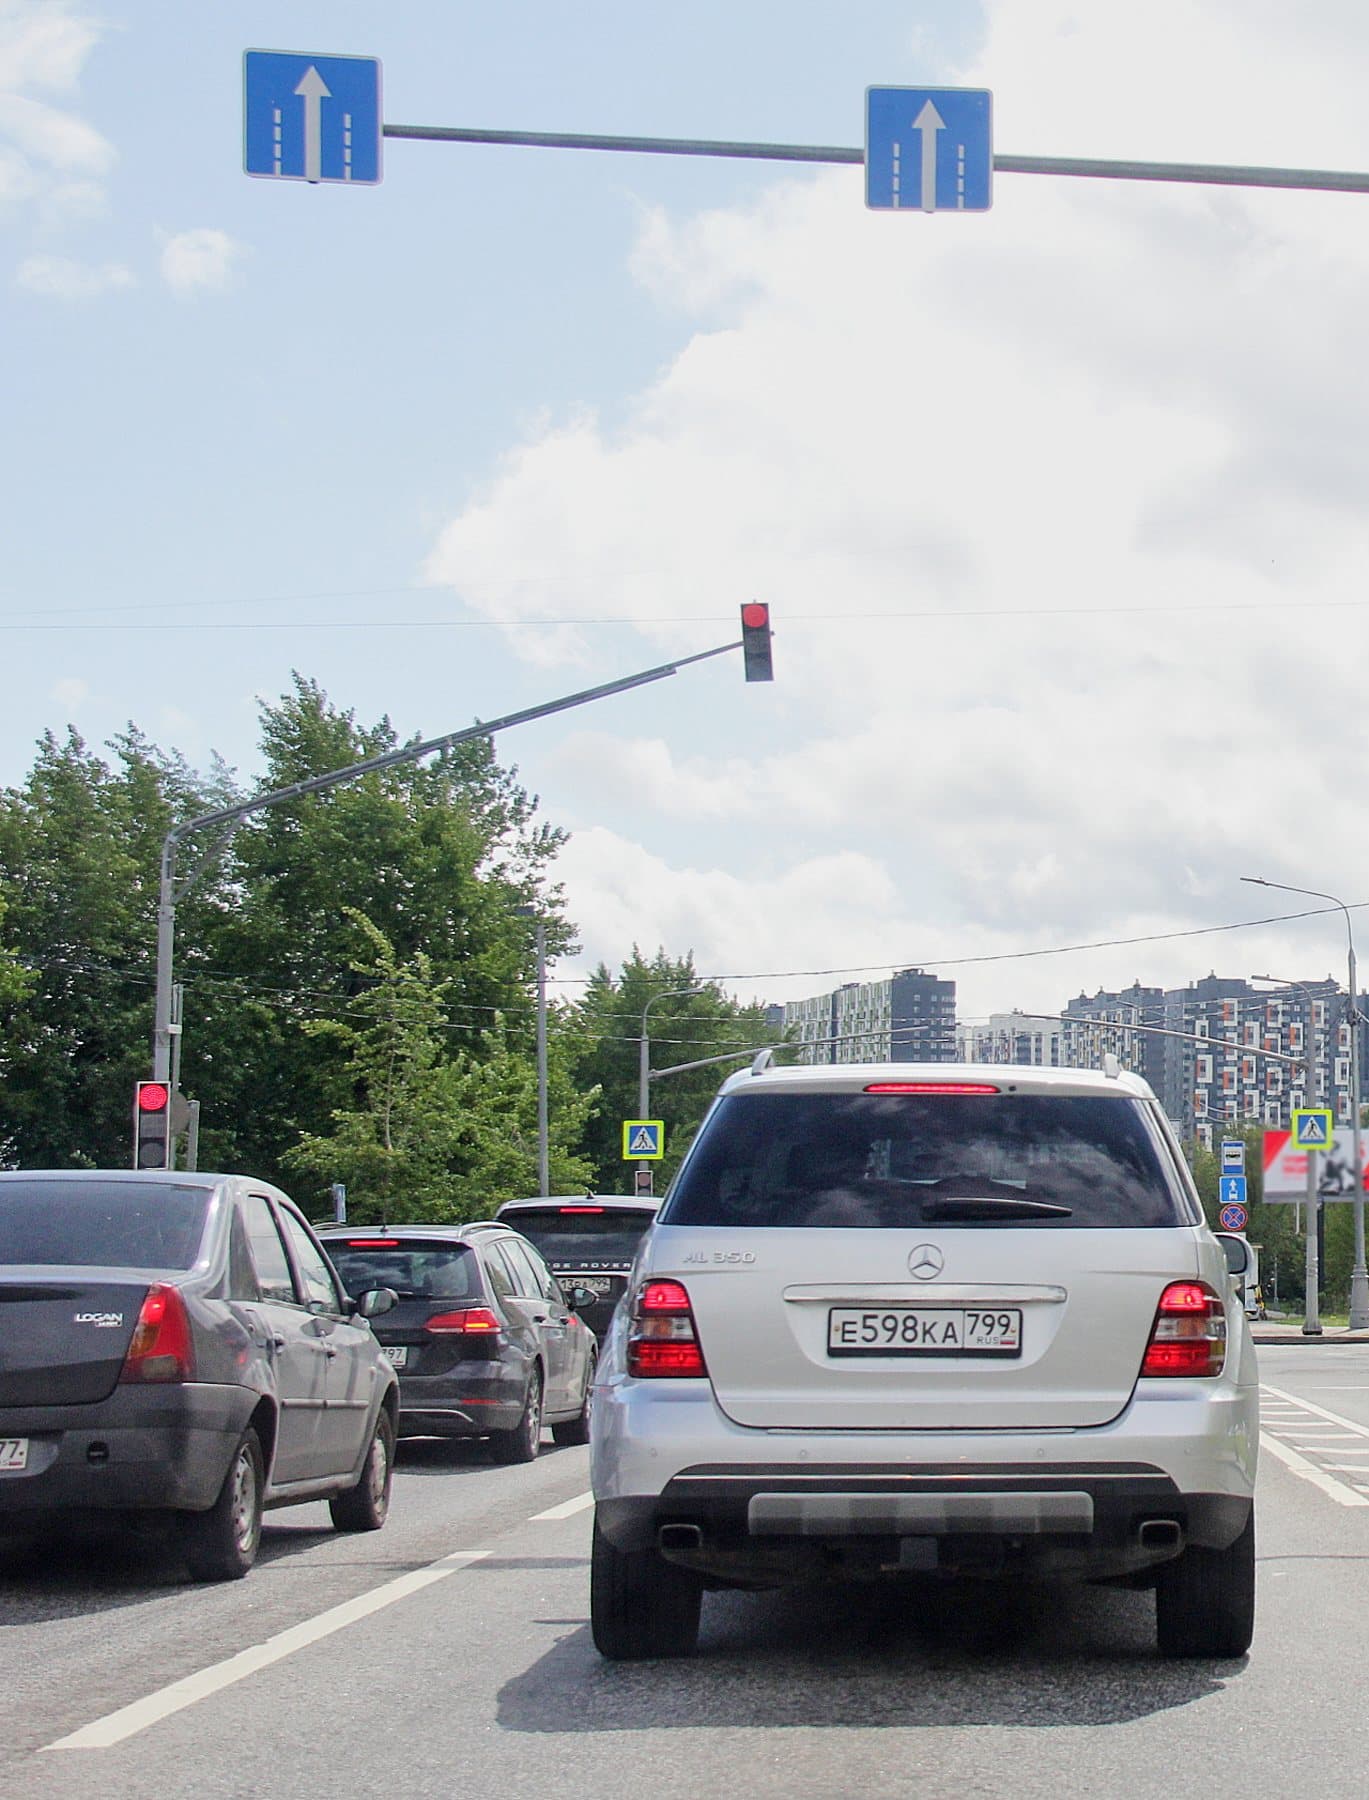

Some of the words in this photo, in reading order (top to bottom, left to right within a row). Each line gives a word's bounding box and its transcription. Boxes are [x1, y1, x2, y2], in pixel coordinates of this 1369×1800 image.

[713, 1251, 756, 1264] 350
[76, 1312, 123, 1322] LOGAN
[967, 1313, 1011, 1336] 799
[976, 1336, 999, 1345] RUS
